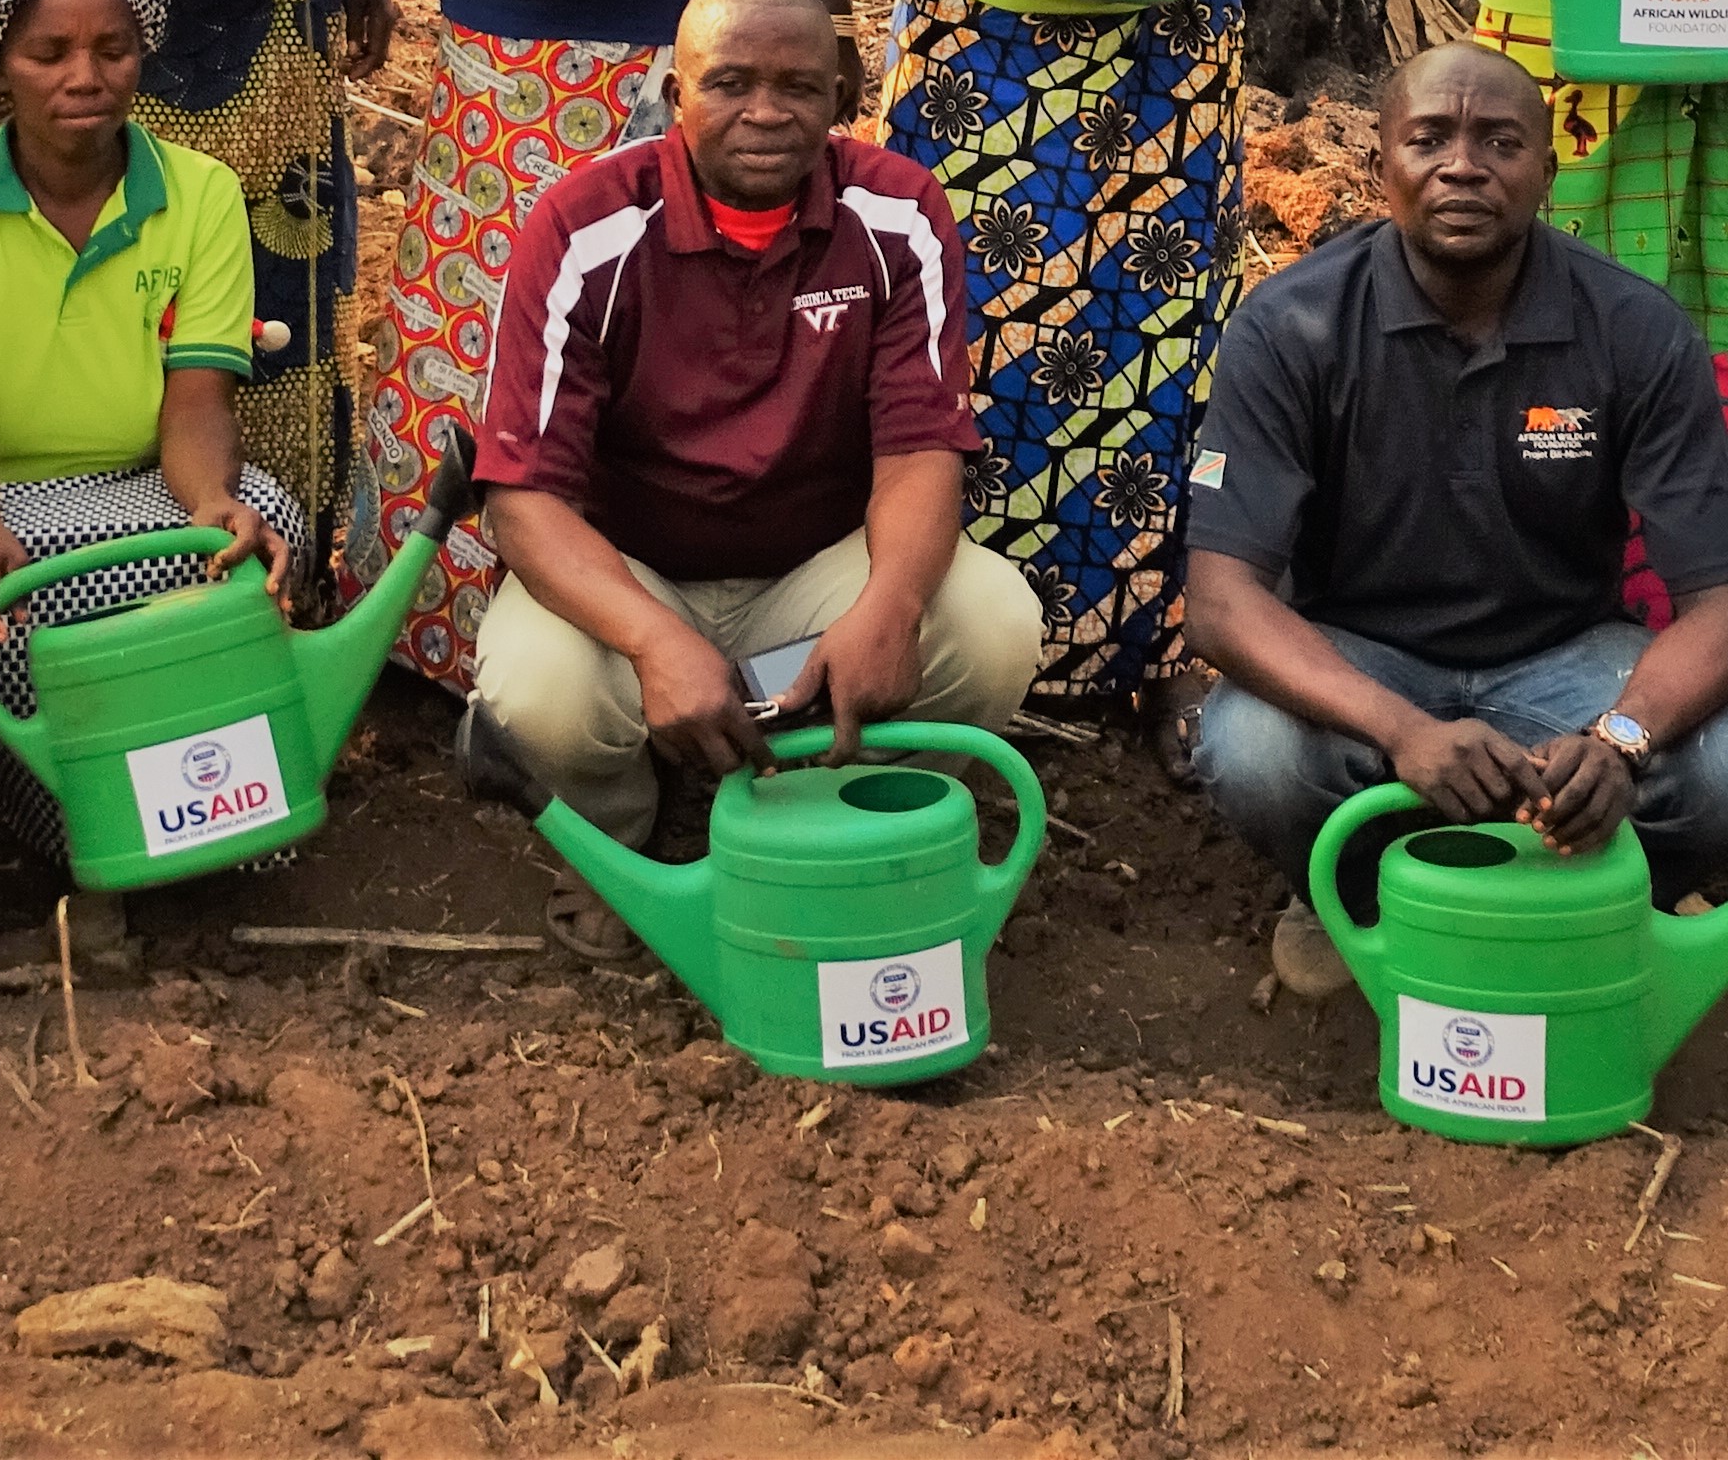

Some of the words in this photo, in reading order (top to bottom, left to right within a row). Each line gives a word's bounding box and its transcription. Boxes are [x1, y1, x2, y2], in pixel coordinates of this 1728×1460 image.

[1633, 8, 1685, 19] AFRICAN
[1648, 22, 1727, 33] FOUNDATION
[832, 285, 865, 302] TECH
[802, 303, 849, 333] VT
[1517, 432, 1556, 442] AFRICAN
[1557, 431, 1598, 441] WILDLIFE
[158, 781, 269, 832] USAID
[839, 1007, 951, 1047] USAID
[841, 1050, 866, 1058] FROM
[867, 1048, 884, 1056] THE
[1412, 1059, 1526, 1101] USAID
[1412, 1088, 1434, 1099] FROM
[1436, 1094, 1450, 1103] THE
[1452, 1098, 1496, 1111] AMERICAN
[1497, 1104, 1527, 1113] PEOPLE
